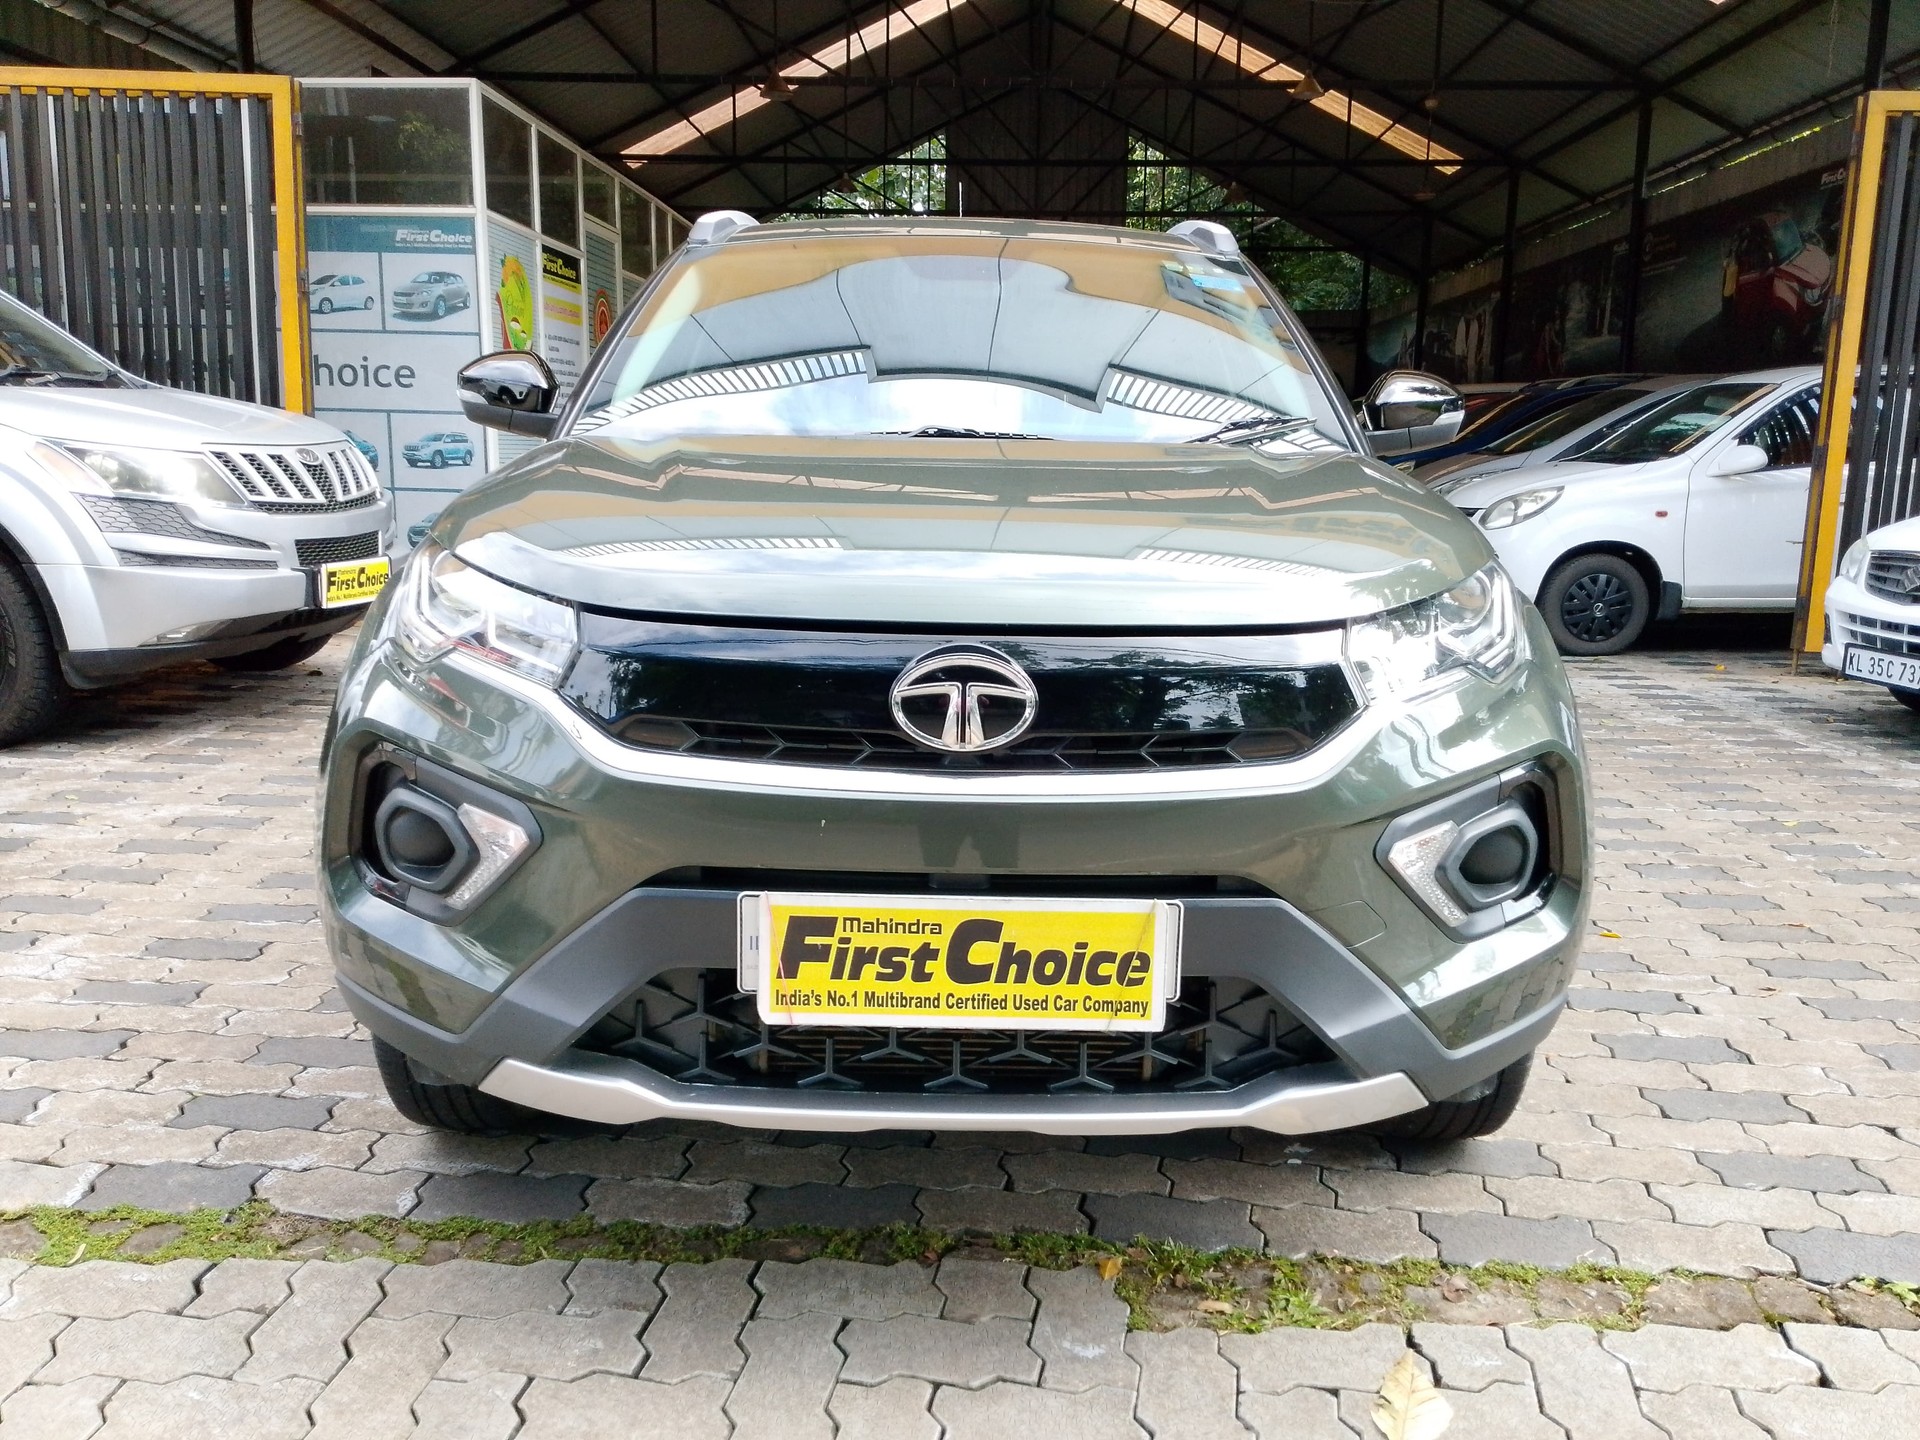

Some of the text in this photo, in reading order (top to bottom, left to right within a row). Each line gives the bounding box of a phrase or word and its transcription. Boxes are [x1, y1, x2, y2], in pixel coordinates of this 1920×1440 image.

[395, 229, 473, 243] First Choice
[313, 354, 416, 389] hoice
[327, 566, 389, 593] First Choice
[1848, 652, 1863, 673] KL
[1868, 656, 1895, 679] 35C
[842, 917, 942, 935] Mahindra
[776, 915, 1151, 987] First Choice
[775, 989, 1149, 1018] India's No.1 Multibrand Certified Used Car Company
